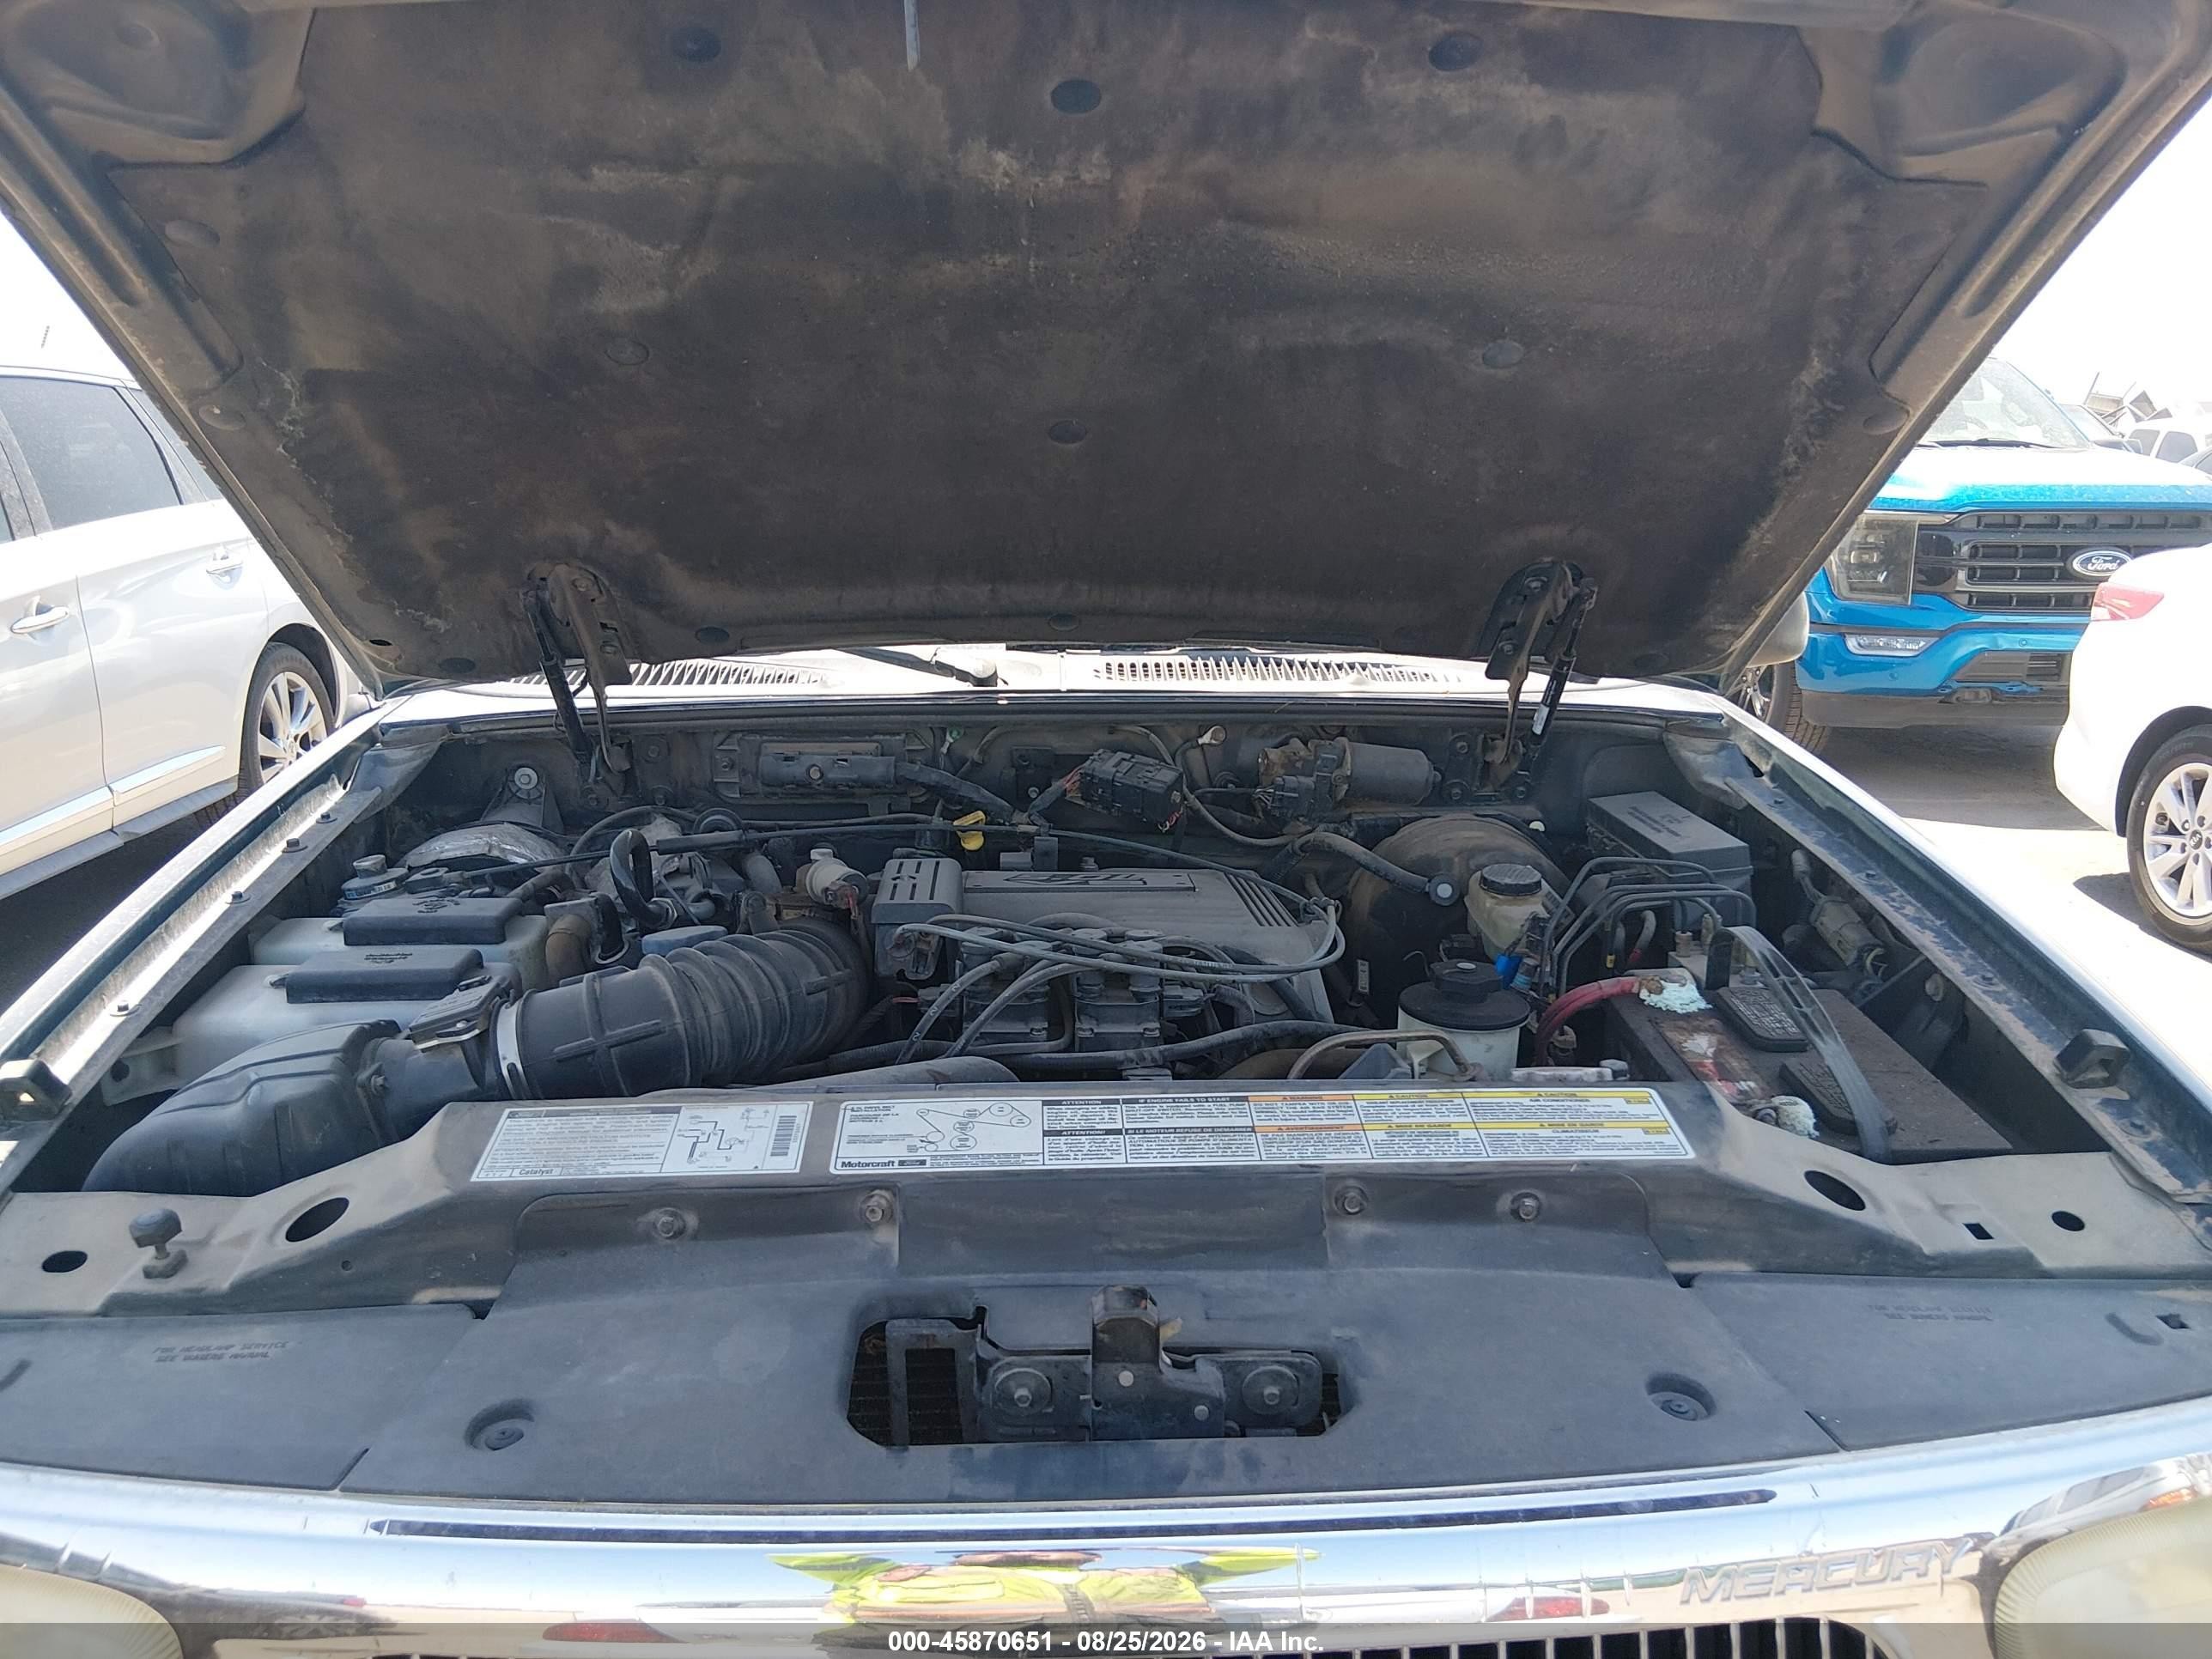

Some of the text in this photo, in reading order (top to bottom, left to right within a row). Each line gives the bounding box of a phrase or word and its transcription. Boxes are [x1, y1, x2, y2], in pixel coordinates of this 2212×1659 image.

[2087, 556, 2120, 570] Ford
[842, 1159, 895, 1168] Motorcraft
[1680, 1537, 1974, 1604] MERCURY
